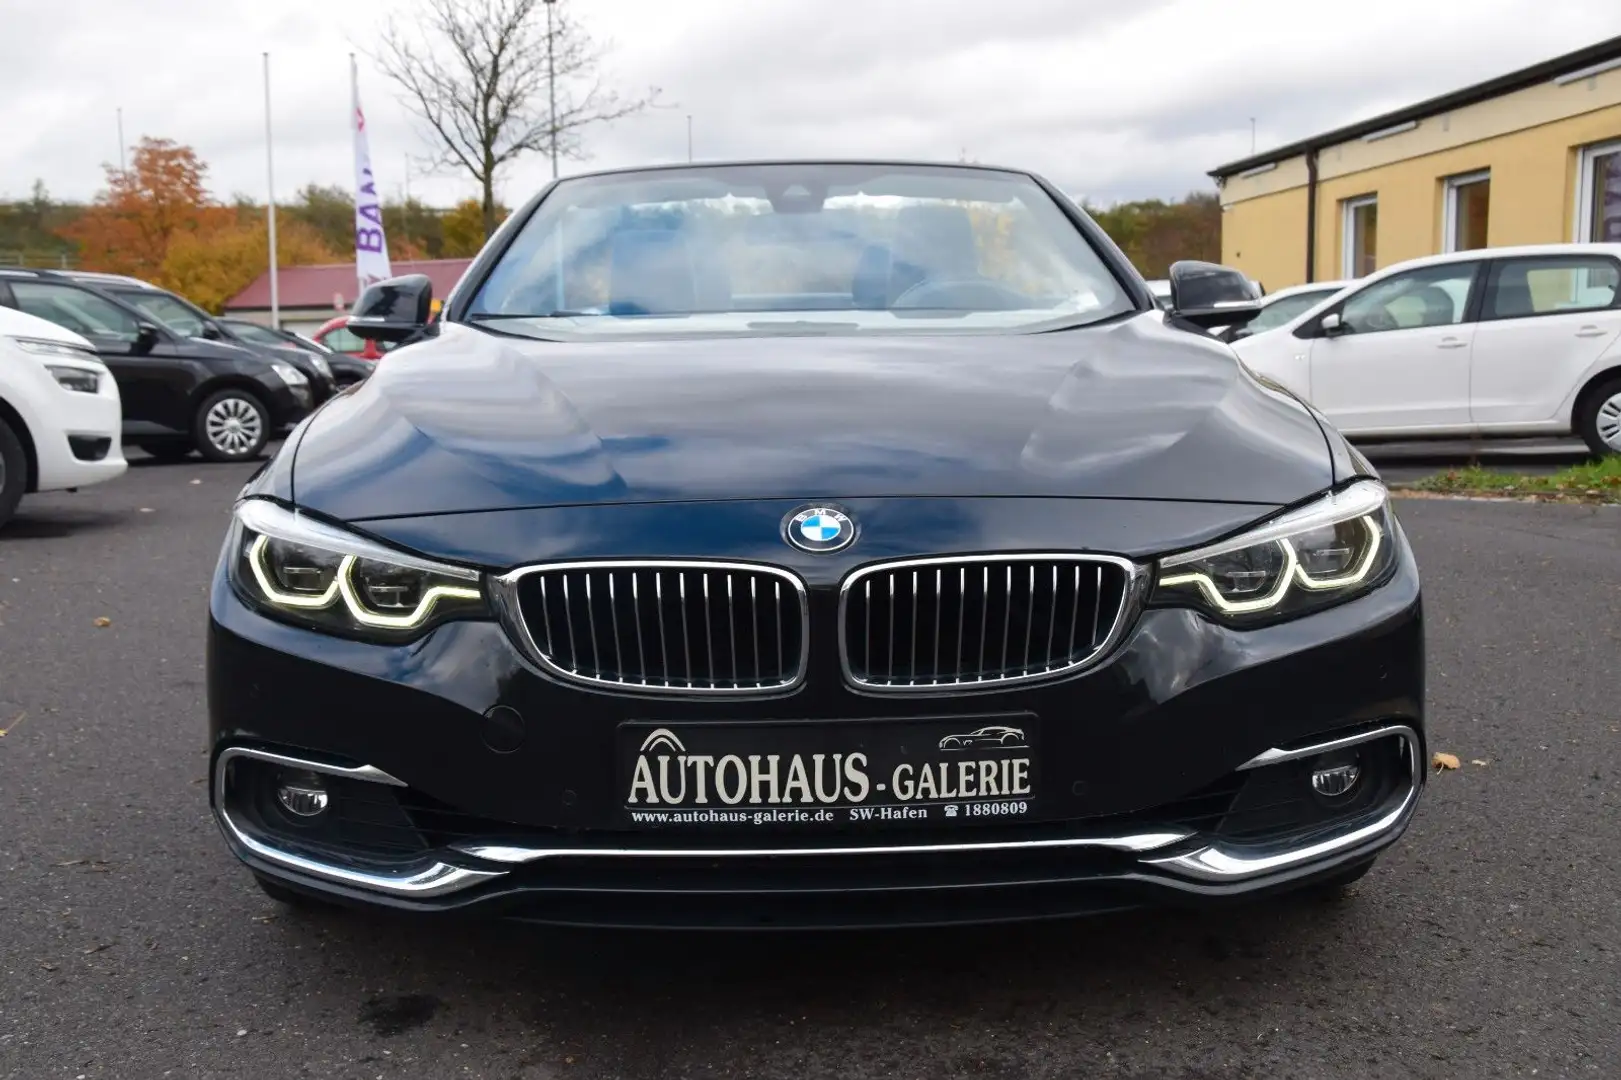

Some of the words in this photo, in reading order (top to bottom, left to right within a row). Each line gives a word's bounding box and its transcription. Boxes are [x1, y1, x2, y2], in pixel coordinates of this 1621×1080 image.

[795, 508, 848, 522] BMW
[631, 807, 835, 826] www.autohaus-galerie.de
[849, 807, 929, 822] SW-Hafen
[964, 802, 1028, 817] 1880809
